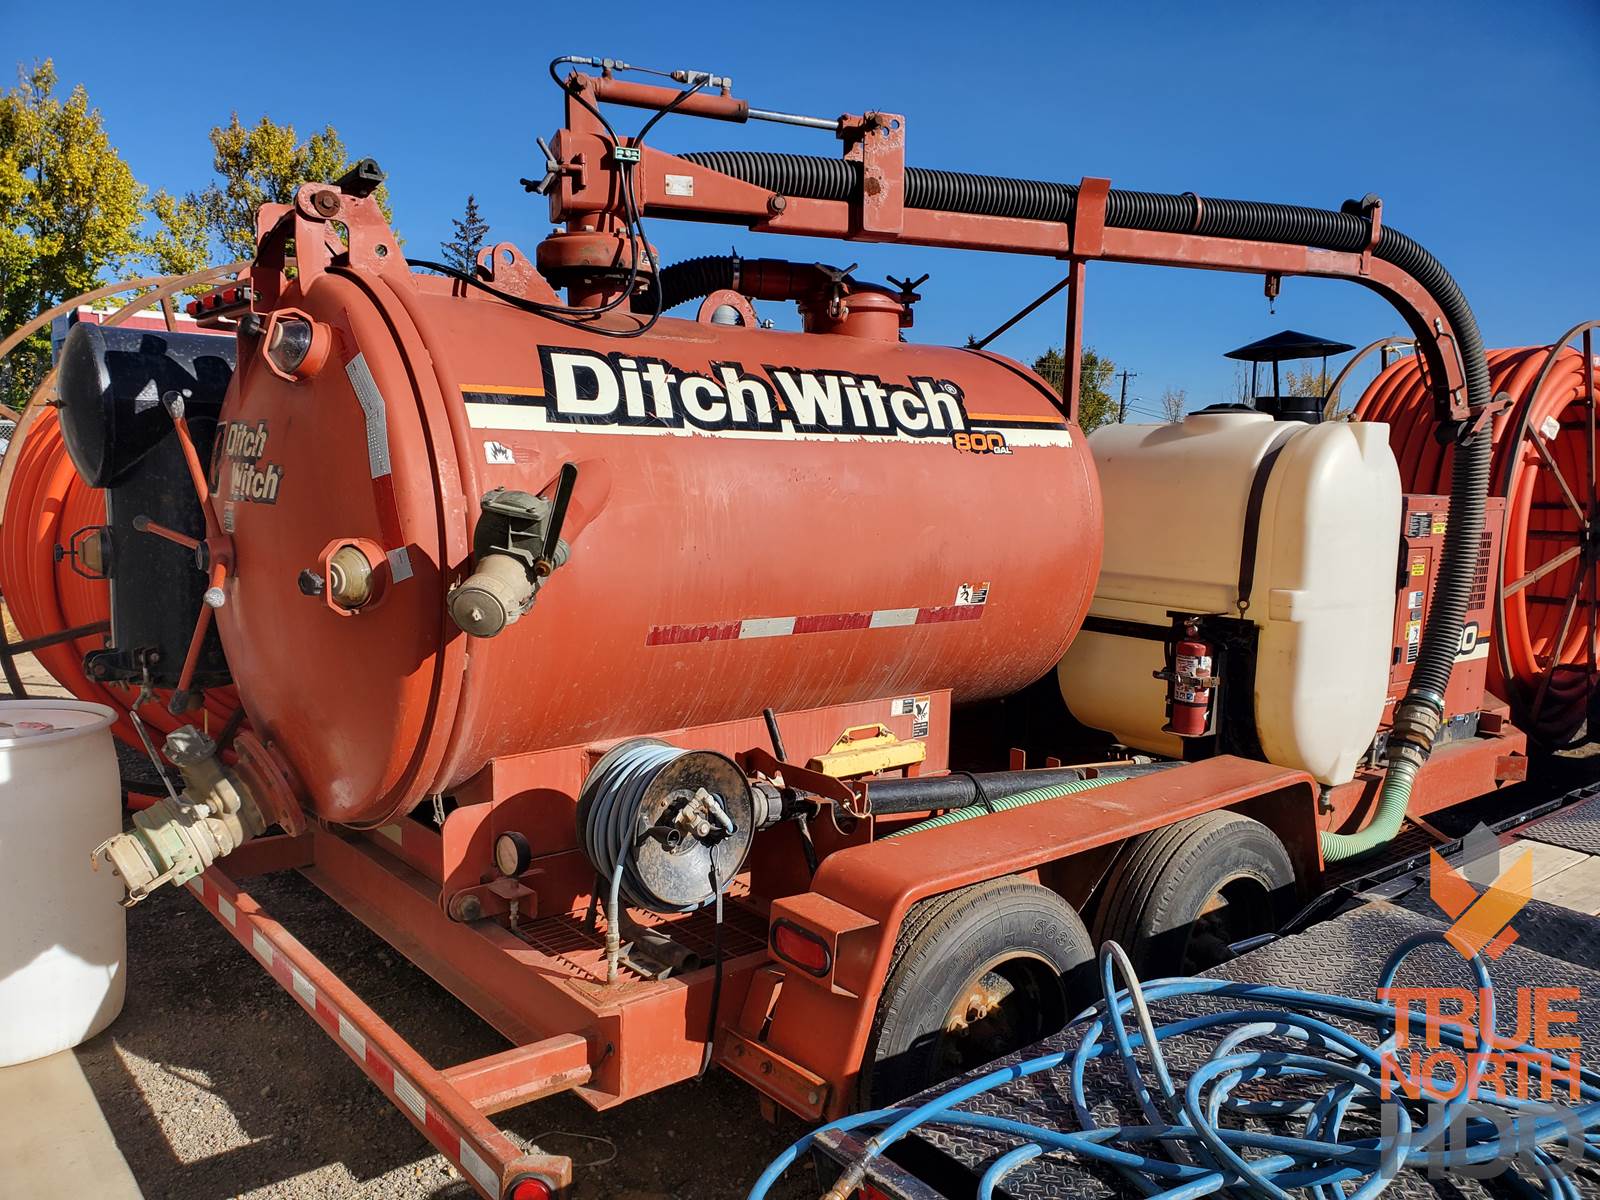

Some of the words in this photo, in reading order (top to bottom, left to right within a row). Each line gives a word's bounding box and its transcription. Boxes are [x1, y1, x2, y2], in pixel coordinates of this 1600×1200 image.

[550, 352, 773, 423] Ditch
[226, 423, 267, 457] Ditch
[954, 432, 1003, 451] 800
[993, 446, 1012, 454] GAL
